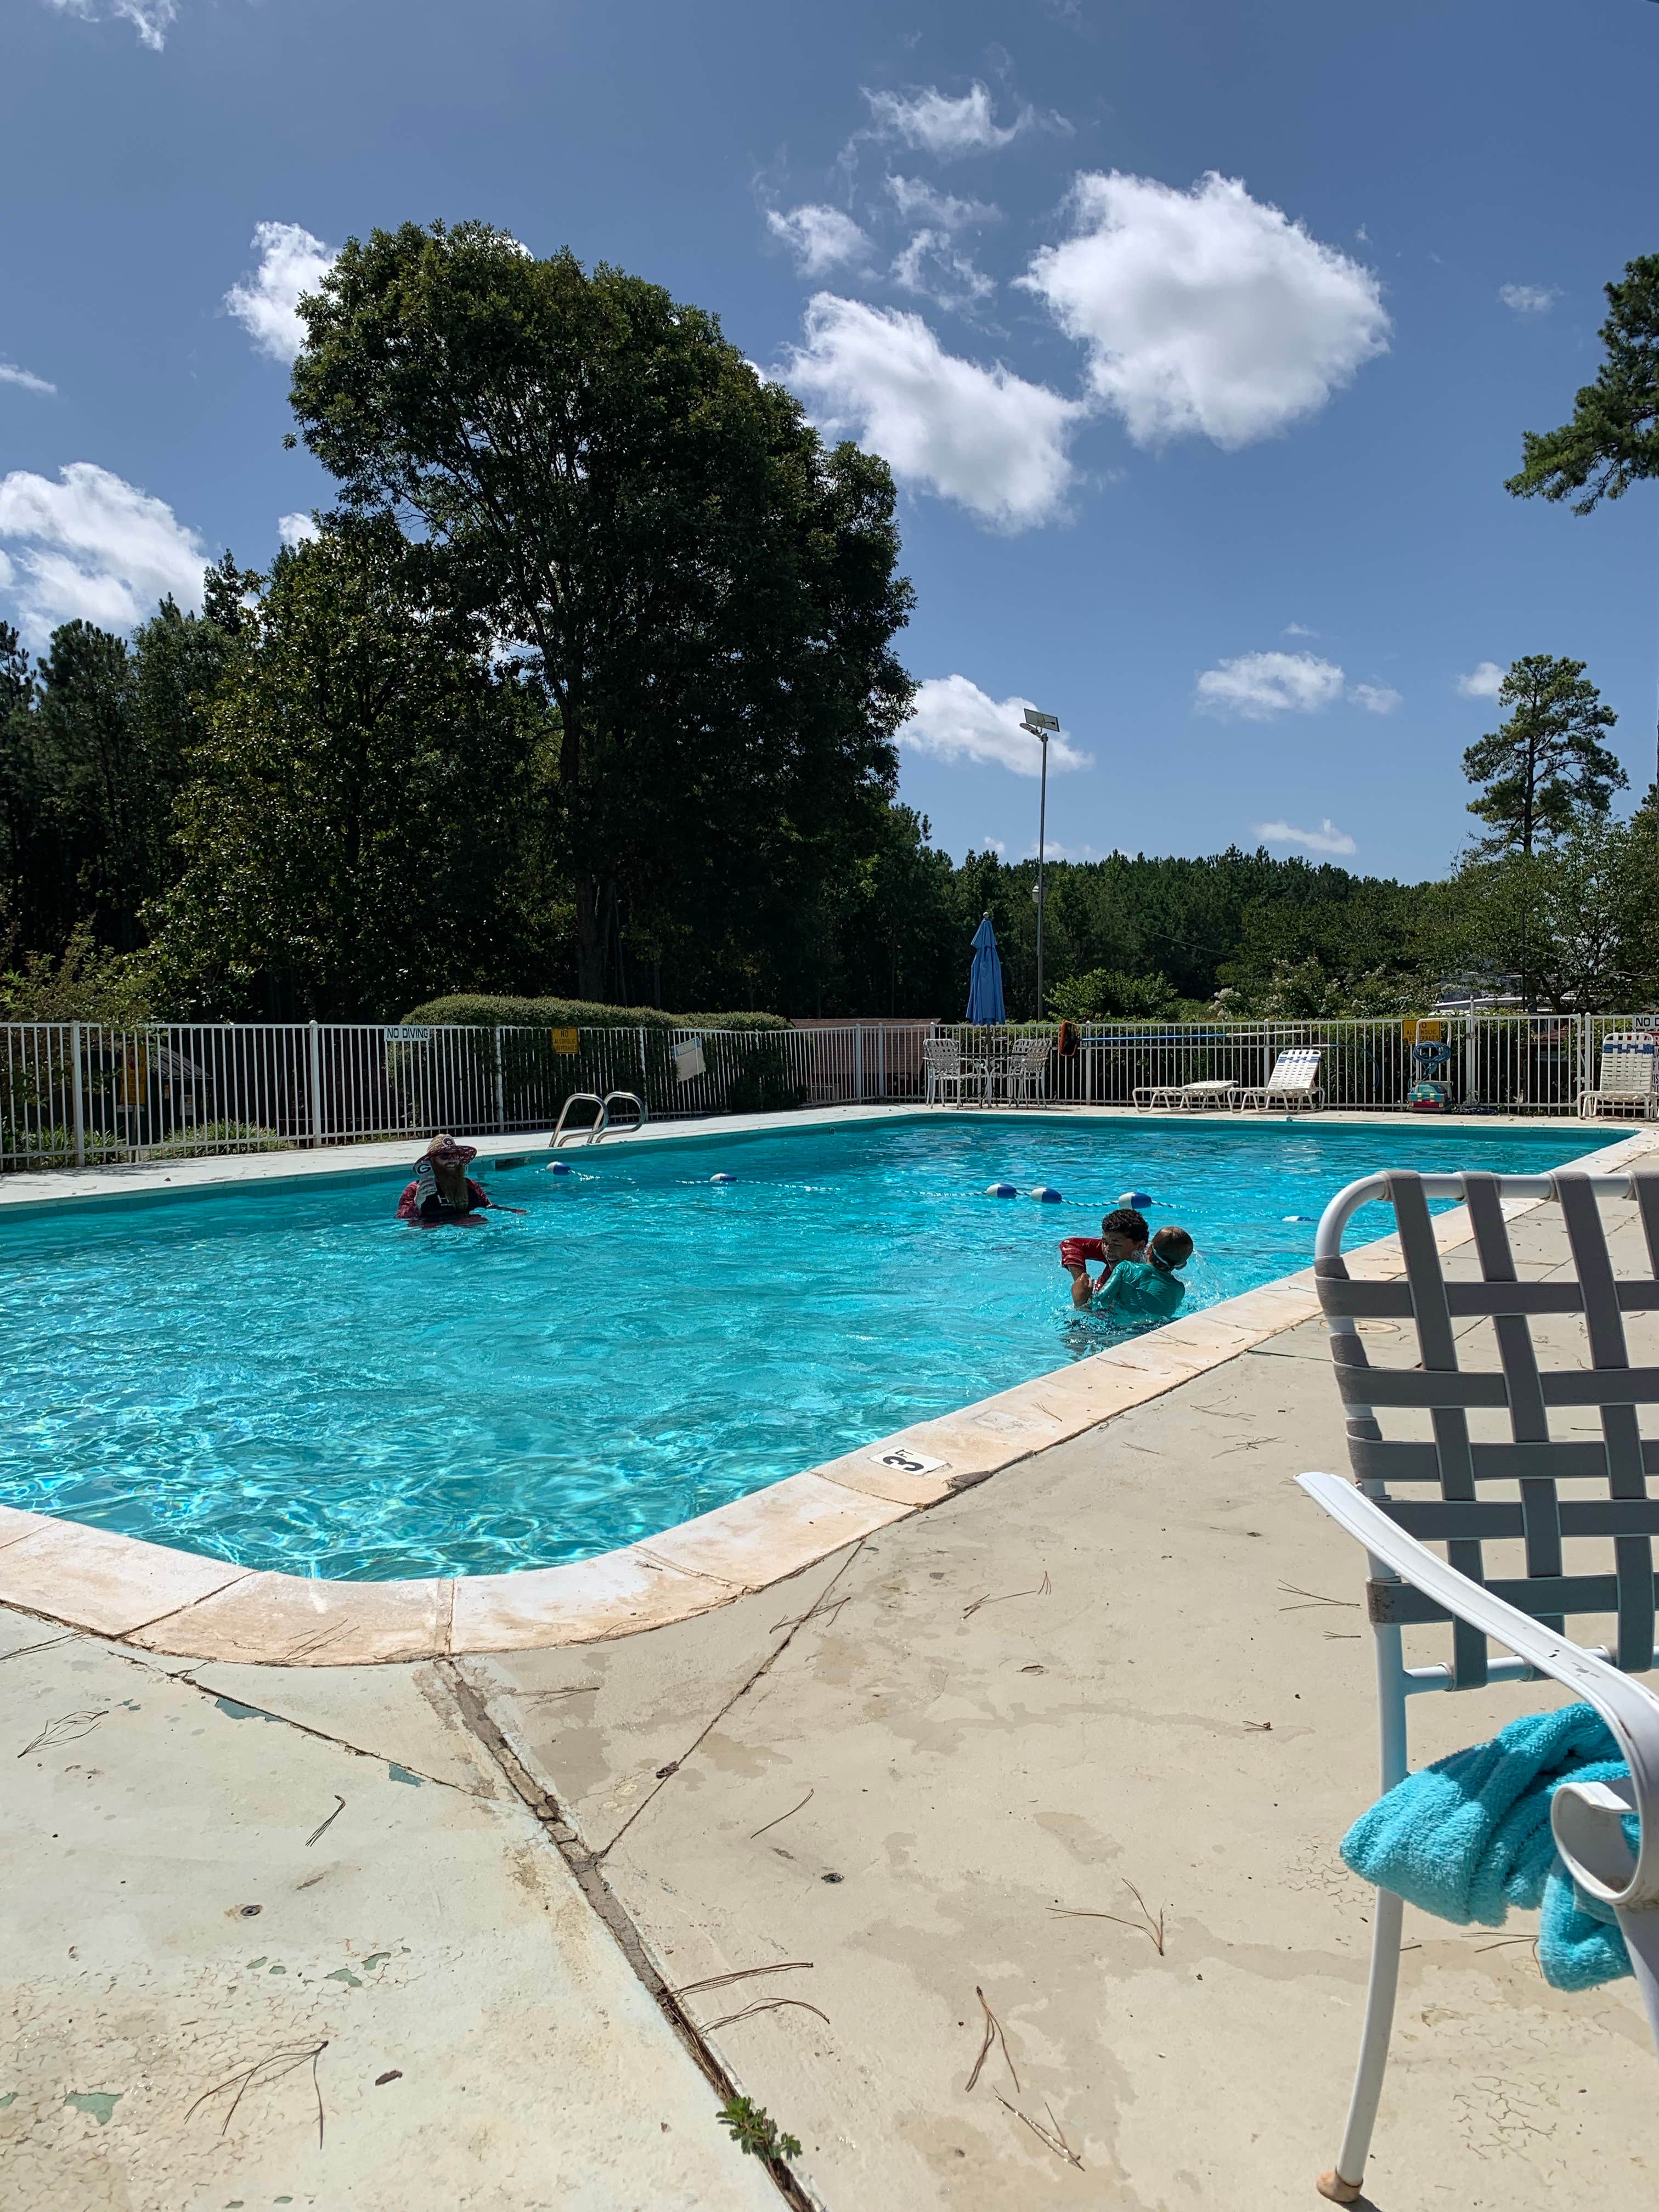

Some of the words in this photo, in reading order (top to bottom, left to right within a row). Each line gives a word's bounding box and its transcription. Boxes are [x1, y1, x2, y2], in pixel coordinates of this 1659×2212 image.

[1635, 1017, 1650, 1026] NO
[387, 1028, 399, 1039] NO
[402, 1028, 428, 1039] DIVING
[894, 1449, 913, 1458] FT
[883, 1456, 924, 1471] 3
